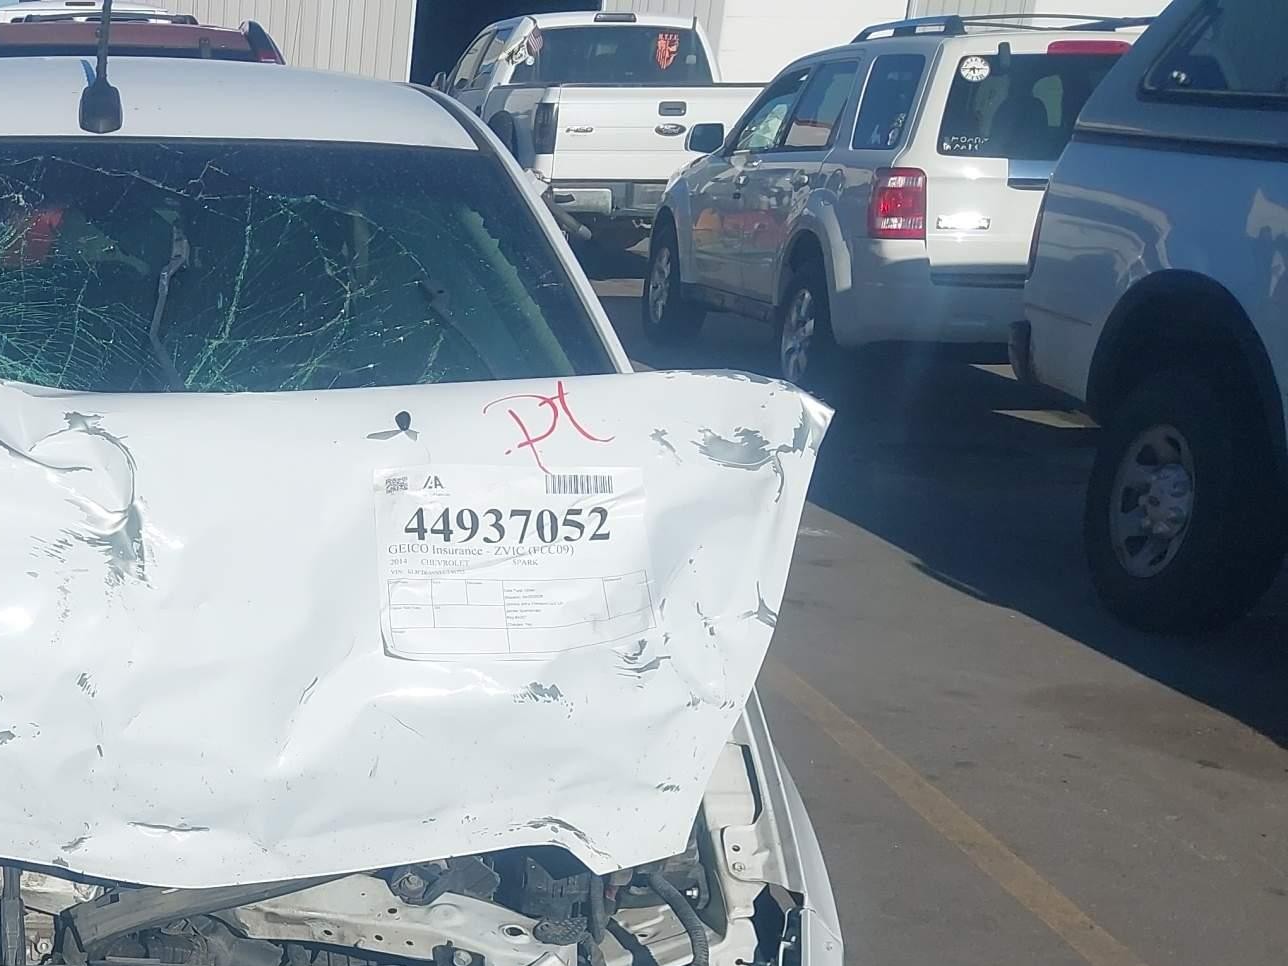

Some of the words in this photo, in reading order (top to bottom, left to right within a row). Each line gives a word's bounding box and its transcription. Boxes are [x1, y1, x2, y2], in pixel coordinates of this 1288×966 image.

[404, 507, 611, 544] 44937052
[388, 543, 429, 555] GEICO
[432, 544, 483, 556] Insurance
[420, 558, 471, 568] CHEVROLET
[512, 559, 539, 567] SPARK
